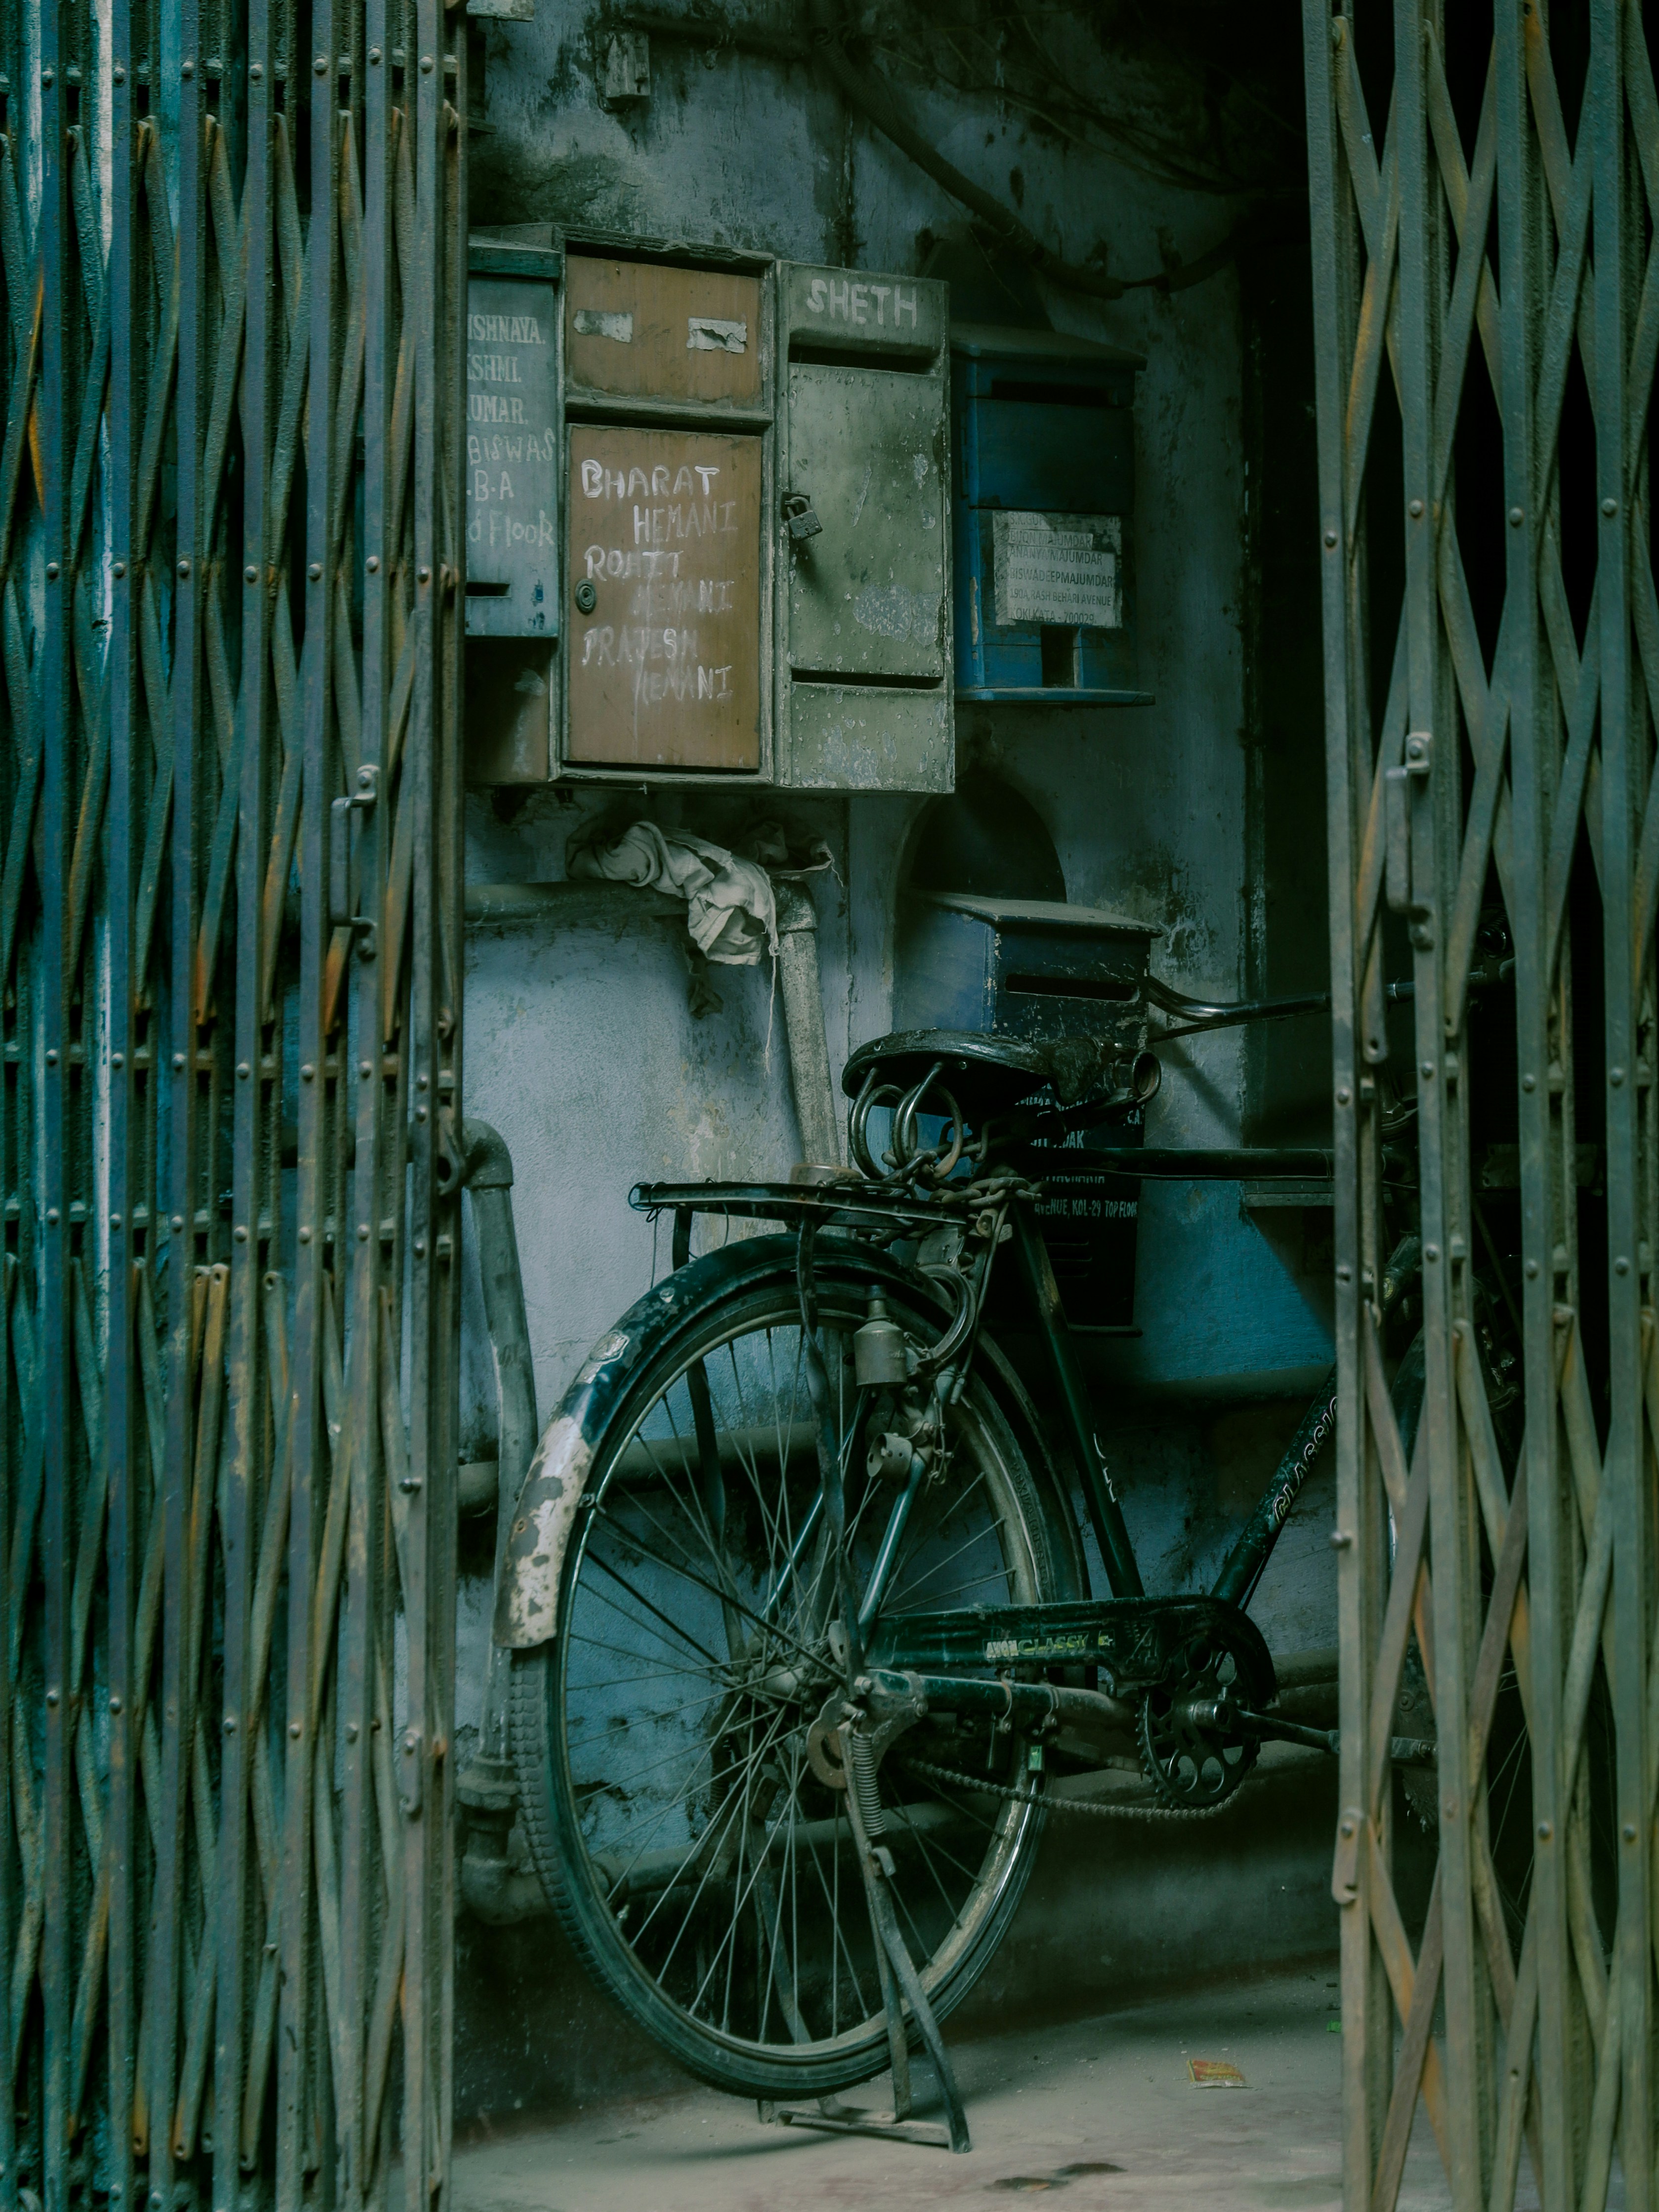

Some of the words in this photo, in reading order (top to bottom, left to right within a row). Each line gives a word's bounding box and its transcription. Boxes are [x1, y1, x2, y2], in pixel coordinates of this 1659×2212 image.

[807, 279, 917, 330] SHETH
[467, 394, 528, 425] UMAR.
[468, 427, 555, 466] BISWAS
[581, 459, 720, 498] BHARAT
[634, 501, 738, 544] HEMANI
[1039, 532, 1091, 548] MAJUMDAR
[1050, 549, 1103, 565] MAJUMDAR
[1053, 592, 1079, 604] BEHARI
[1081, 595, 1112, 606] AVENUE
[1072, 1199, 1101, 1218] KOL-29
[1105, 1200, 1118, 1218] TOP
